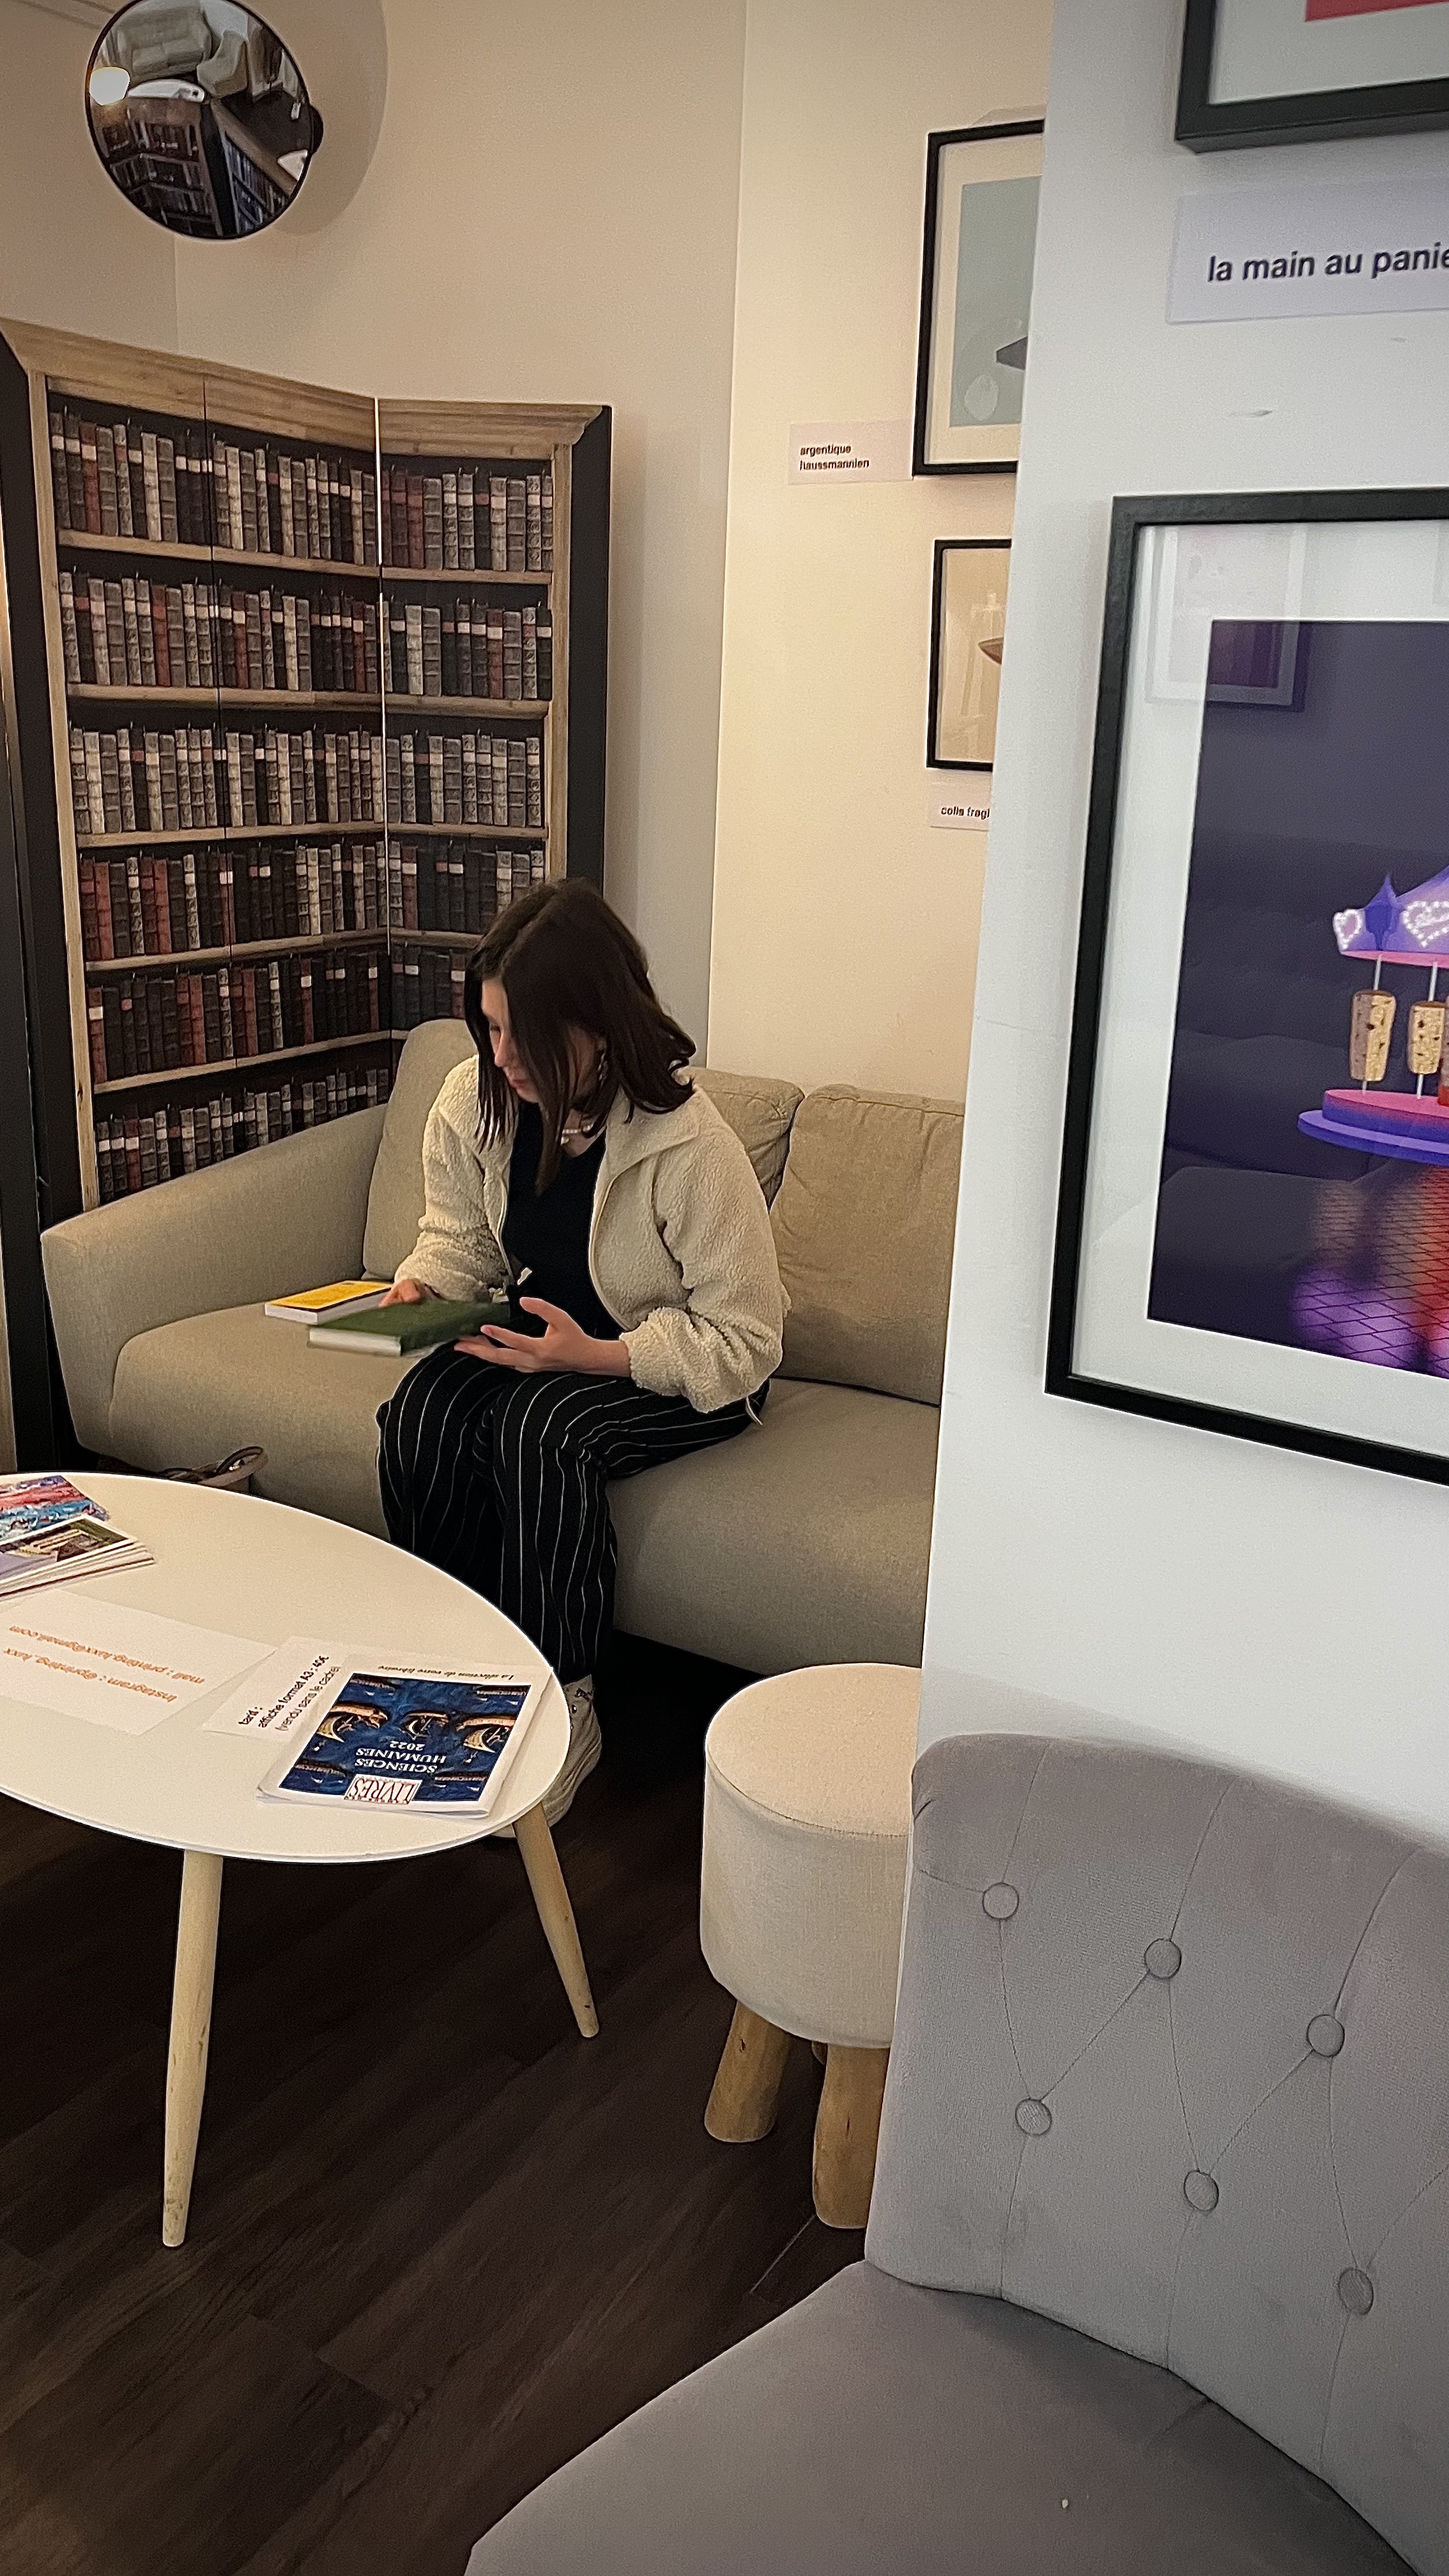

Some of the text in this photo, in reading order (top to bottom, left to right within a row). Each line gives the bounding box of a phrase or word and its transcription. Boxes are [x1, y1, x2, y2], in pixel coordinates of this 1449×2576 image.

[1208, 256, 1232, 282] la
[1243, 250, 1314, 280] main
[1325, 254, 1363, 275] au
[800, 443, 852, 457] argentique
[799, 458, 870, 470] haussmannien
[171, 1672, 205, 1683] mail
[107, 1678, 177, 1703] Instagram
[258, 1705, 284, 1728] affiche
[278, 1681, 306, 1703] format
[300, 1671, 314, 1681] A3
[298, 1692, 317, 1708] sans
[238, 1710, 259, 1724] tarif
[390, 1740, 425, 1751] 2022
[356, 1748, 447, 1763] HUMAINES
[355, 1758, 438, 1774] SCIENCES
[349, 1778, 415, 1804] LIVRES
